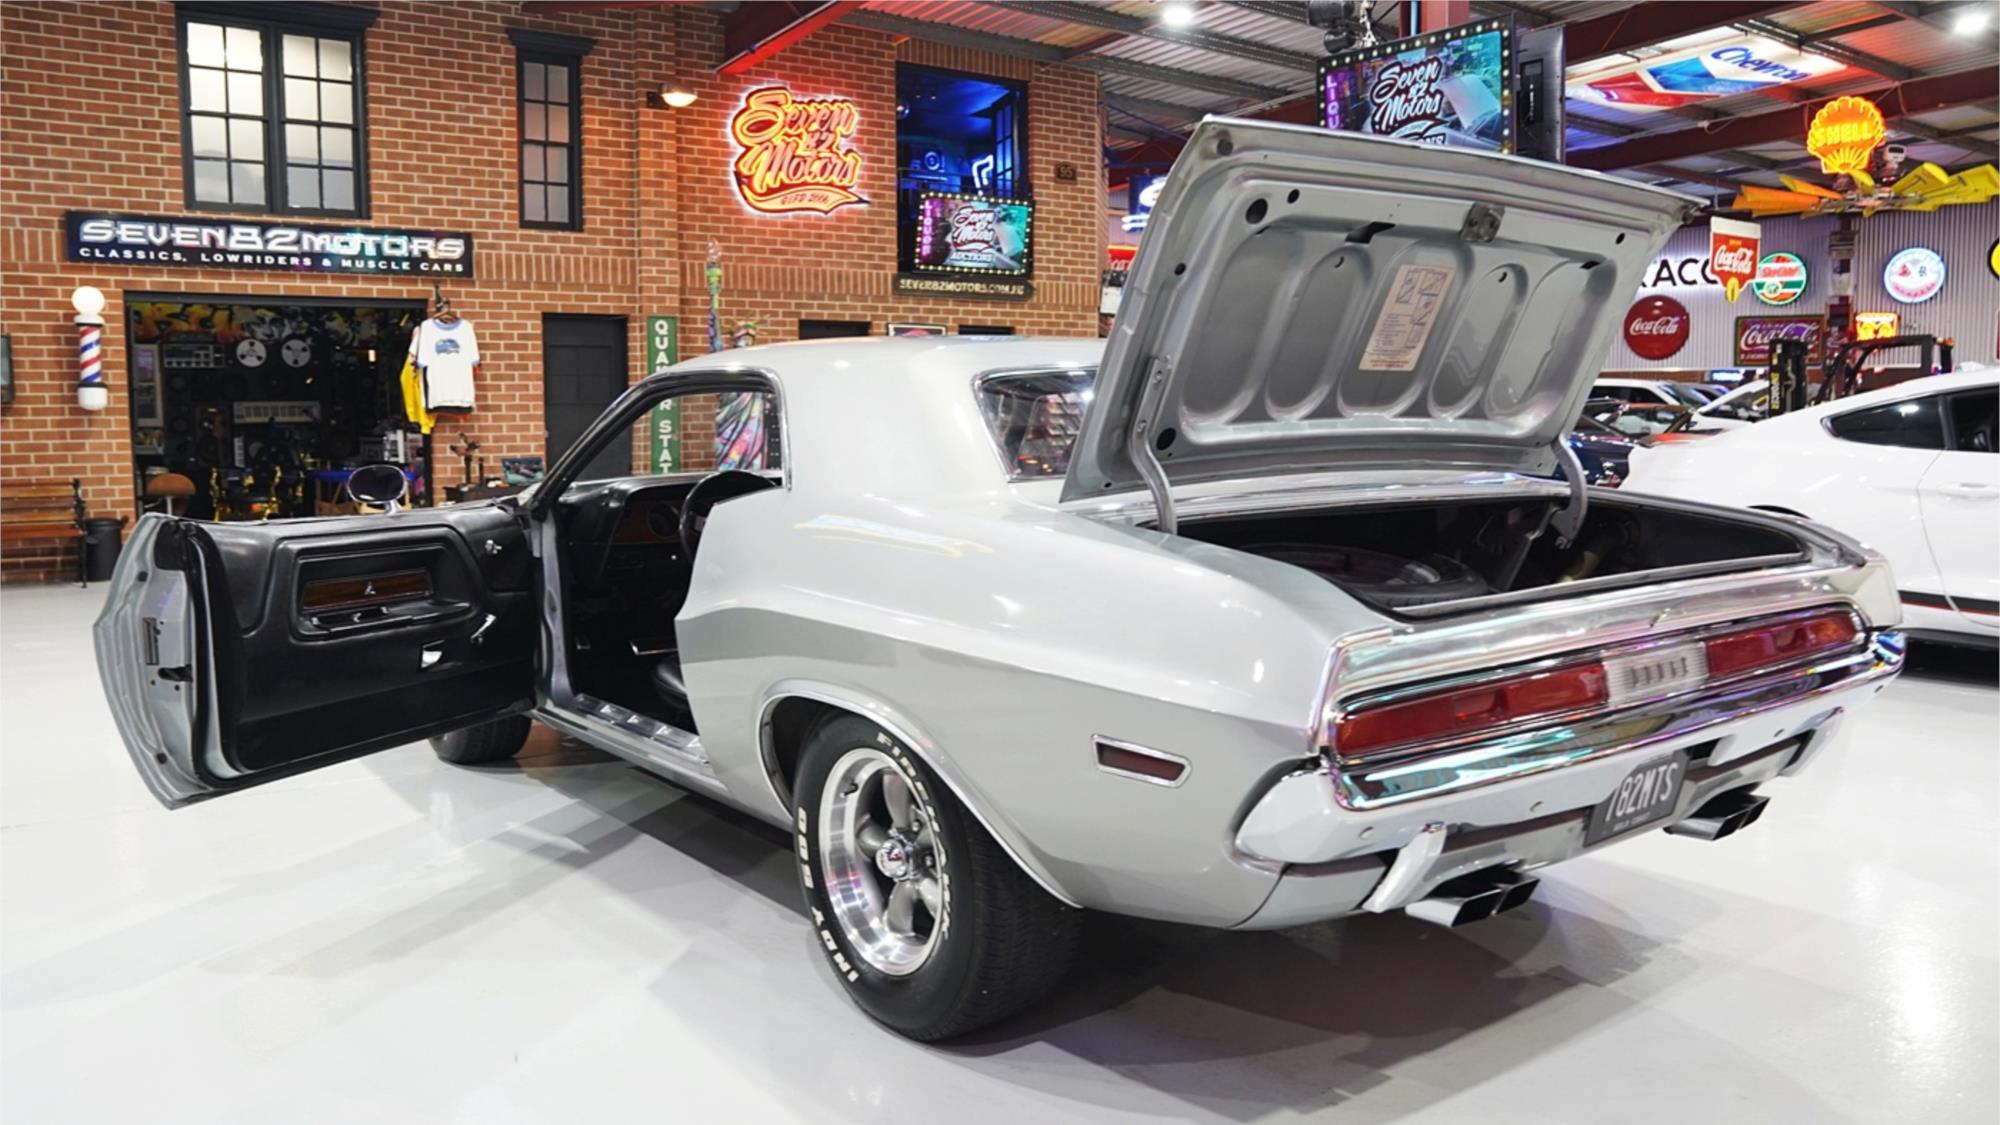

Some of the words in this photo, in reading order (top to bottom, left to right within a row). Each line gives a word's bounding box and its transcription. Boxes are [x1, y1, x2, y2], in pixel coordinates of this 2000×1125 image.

[1372, 60, 1439, 104] Seven
[1710, 46, 1812, 82] Chevron
[736, 87, 859, 147] Seven
[1326, 75, 1341, 130] LIQU
[1374, 92, 1442, 132] Motors
[1817, 121, 1873, 147] SHELL
[739, 140, 862, 194] Motors
[201, 253, 312, 266] LOWRIDERS
[321, 258, 332, 267] &
[341, 259, 411, 270] MUSCLE
[420, 262, 464, 272] CARS
[1630, 316, 1680, 336] Coca-Cola
[654, 319, 672, 411] QUAR
[659, 419, 673, 474] STAT
[797, 806, 815, 889] 500
[811, 906, 860, 983] INDY
